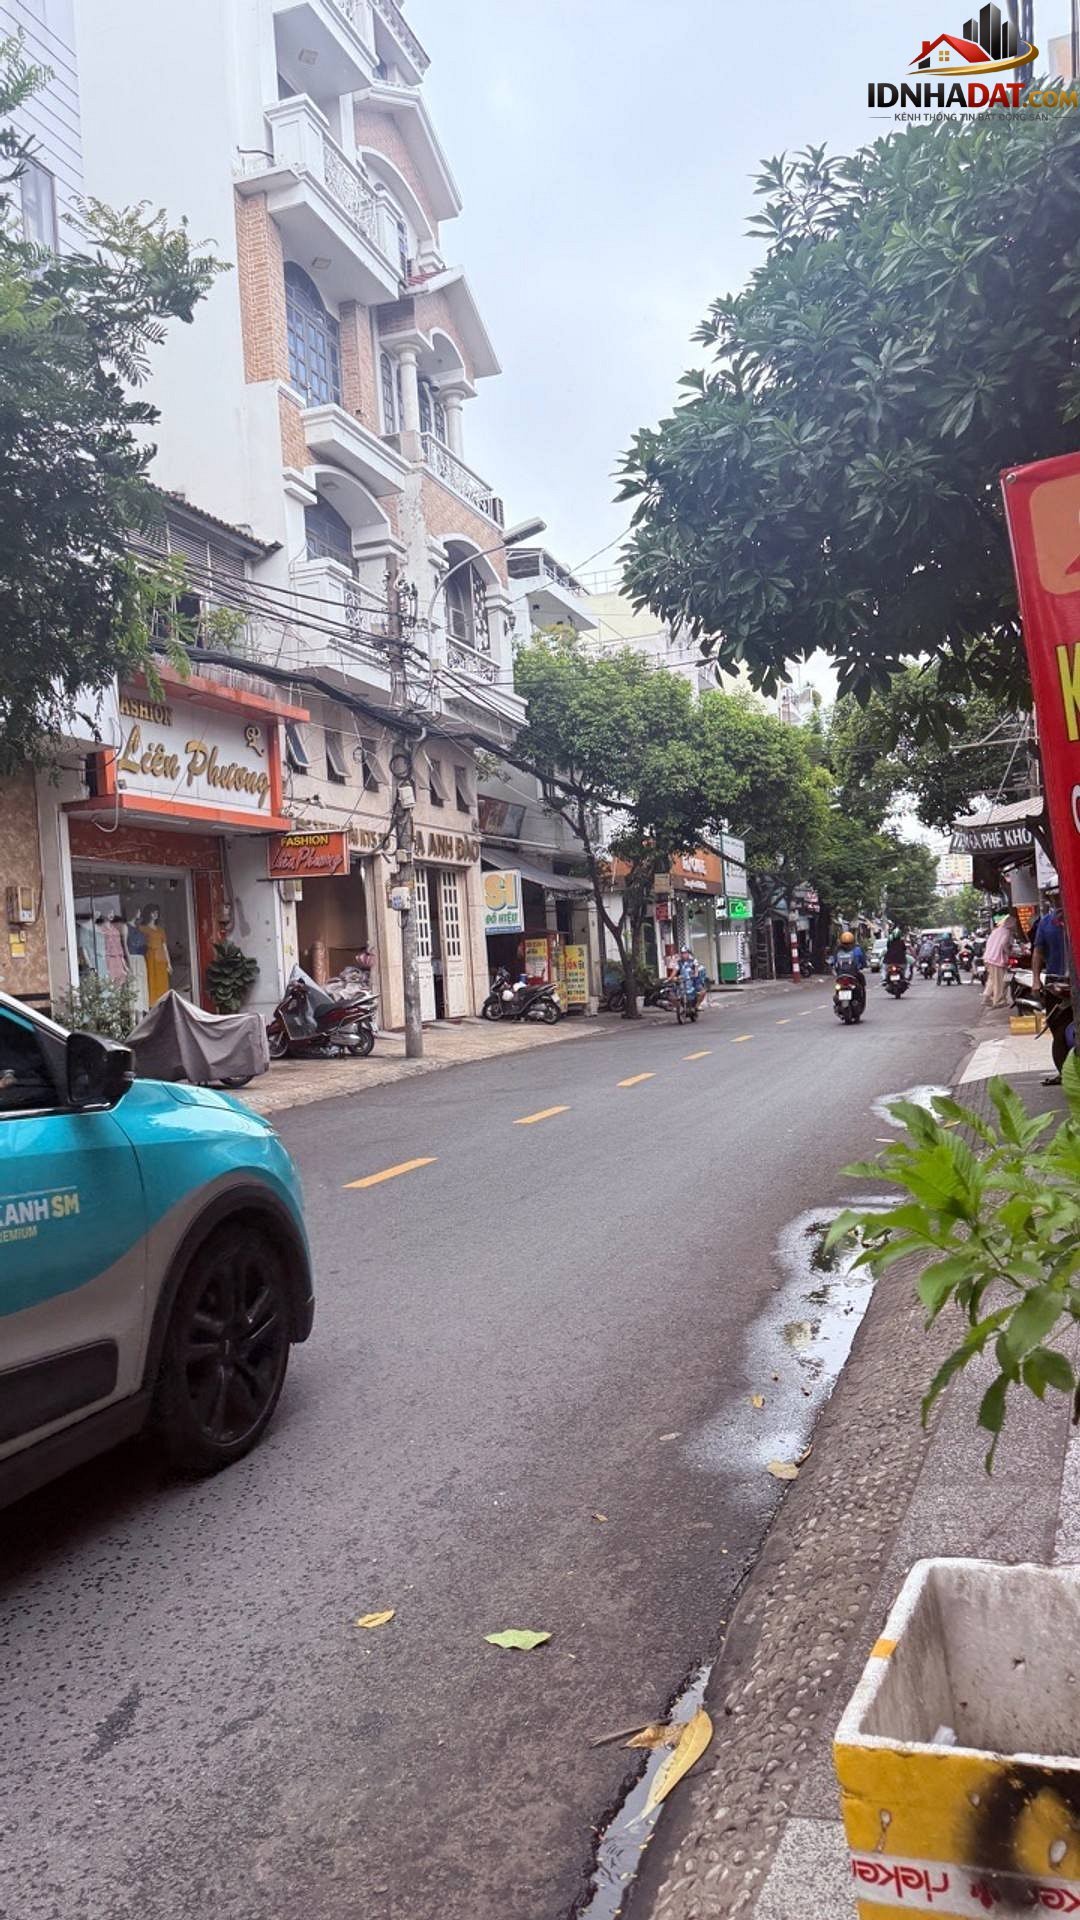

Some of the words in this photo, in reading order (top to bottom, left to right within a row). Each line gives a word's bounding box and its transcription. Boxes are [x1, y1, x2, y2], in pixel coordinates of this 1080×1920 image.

[119, 697, 174, 727] ASHION
[118, 724, 181, 780] Liên
[185, 739, 270, 809] Phương
[281, 834, 329, 848] FASHION
[428, 832, 454, 859] ANH
[51, 1192, 80, 1218] SM
